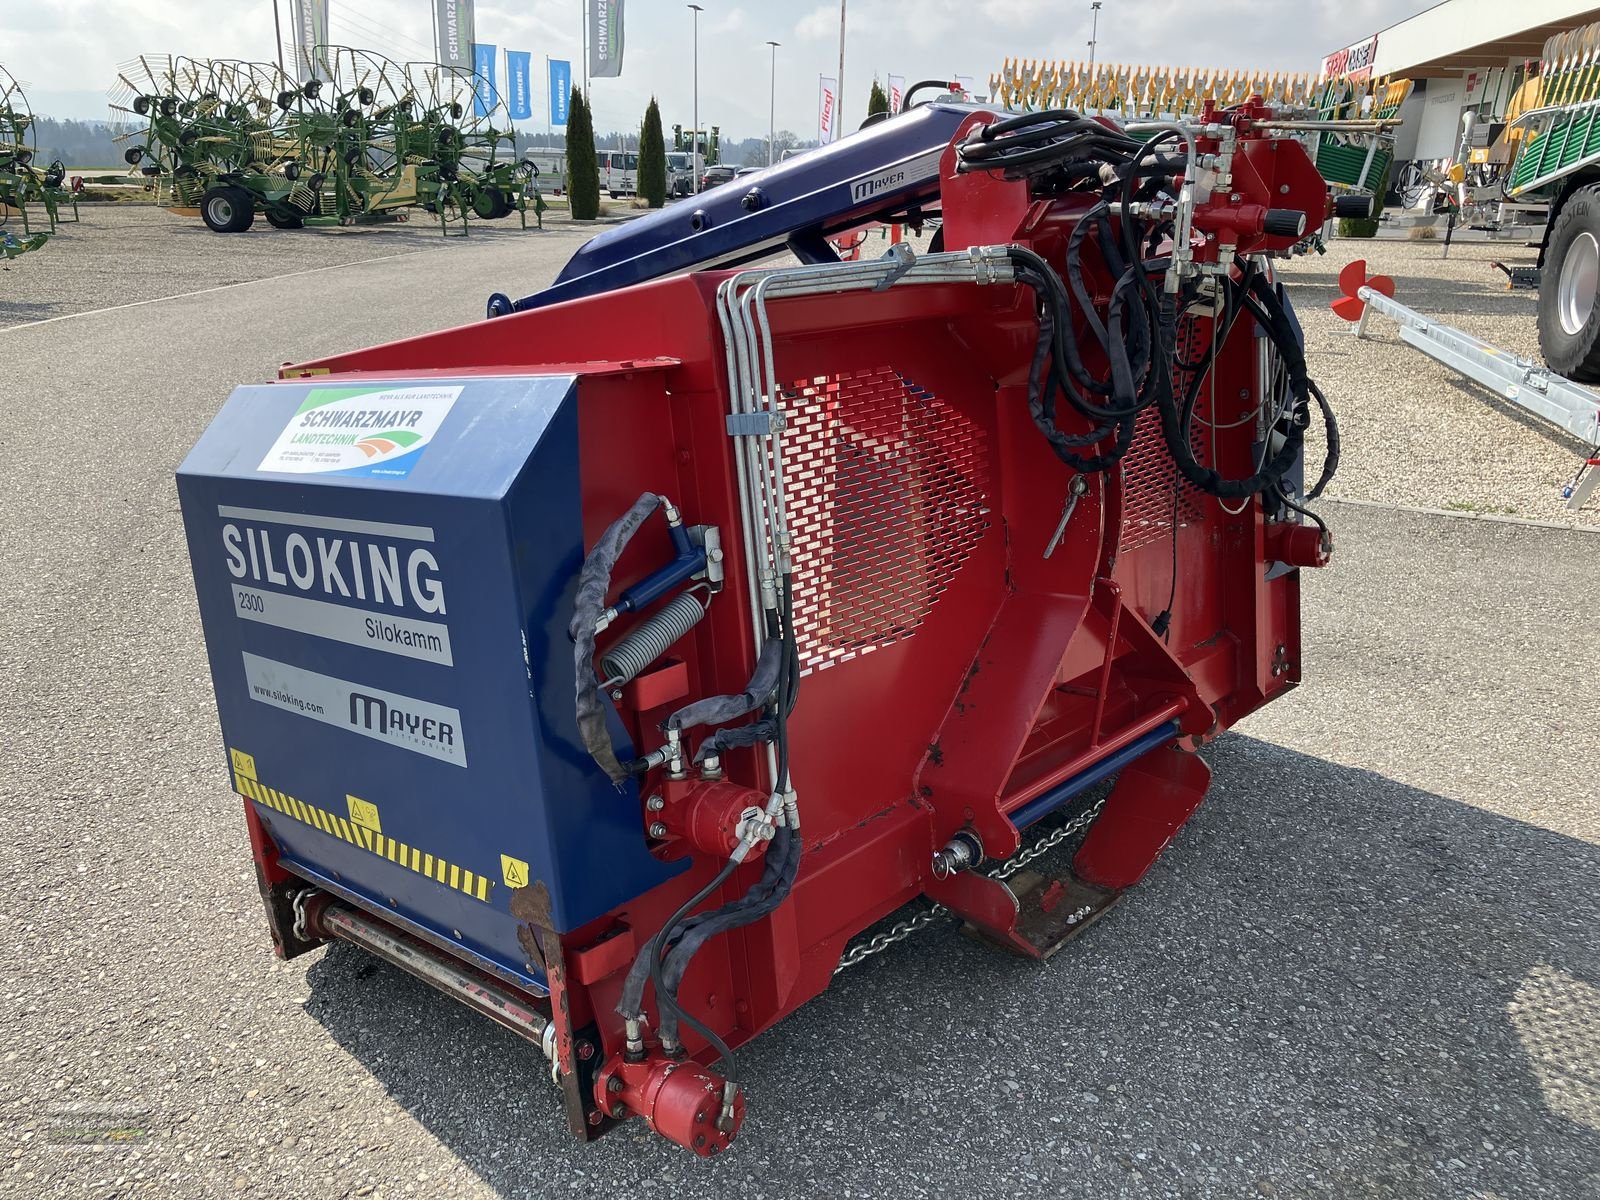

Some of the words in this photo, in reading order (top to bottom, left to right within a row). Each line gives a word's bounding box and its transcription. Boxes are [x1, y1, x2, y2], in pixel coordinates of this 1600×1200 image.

[598, 0, 608, 60] SCHWARZ
[516, 71, 524, 106] LEMKEN
[820, 88, 833, 132] Fliegl
[855, 171, 905, 200] MAYER
[290, 432, 360, 447] LANDTECHNIK
[299, 410, 423, 429] SCHWARZMAYR
[222, 523, 447, 615] SILOKING
[238, 591, 264, 613] 2300
[365, 617, 442, 653] Silokamm
[253, 684, 324, 715] www.siloking.com
[349, 692, 454, 746] MAYER
